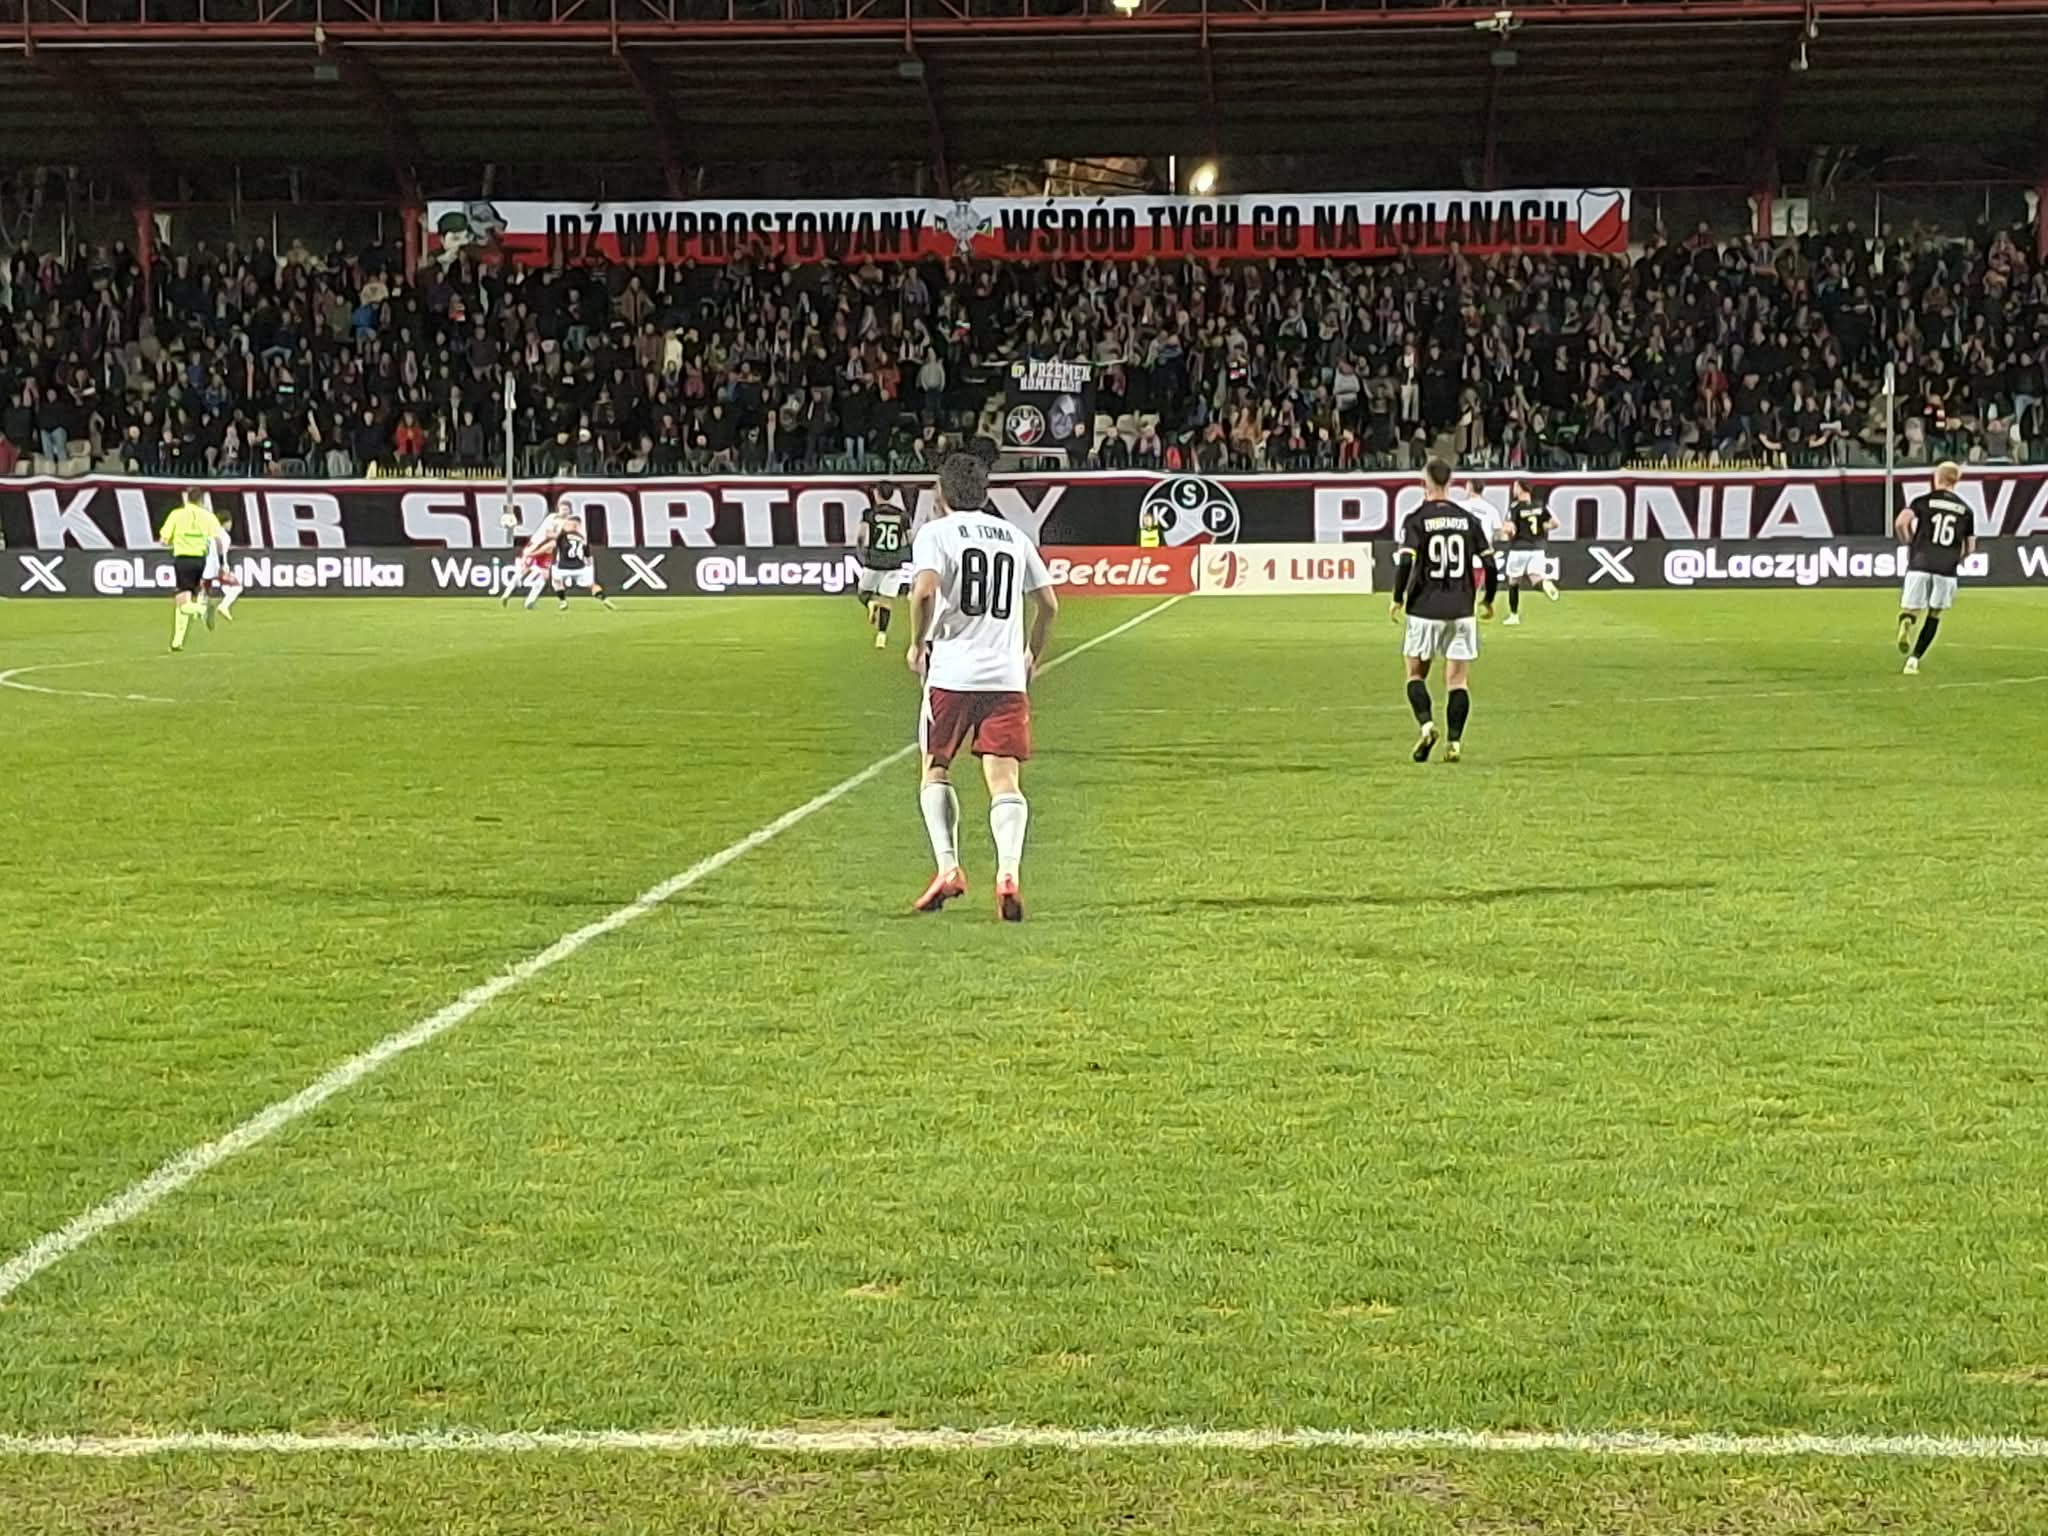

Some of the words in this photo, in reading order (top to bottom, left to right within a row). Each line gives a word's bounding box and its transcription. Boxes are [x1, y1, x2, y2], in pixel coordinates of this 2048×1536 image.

[614, 208, 927, 260] WYPROSTOWANY
[1001, 199, 1135, 253] WŚRÓD
[1148, 204, 1238, 251] TYCH
[1252, 204, 1300, 250] CO
[1313, 204, 1362, 249] NA
[1374, 199, 1567, 249] KOLANACH
[1182, 484, 1198, 506] S
[1210, 508, 1228, 528] P
[875, 523, 899, 550] 26
[1931, 513, 1957, 547] 16
[1048, 556, 1170, 585] Betclic
[1263, 559, 1276, 580] 1
[1291, 558, 1355, 580] LIGA
[1428, 534, 1465, 578] 99
[1663, 546, 1989, 585] @LaczyNasa
[94, 557, 404, 594] @LaNasPilka
[961, 548, 1014, 619] 80
